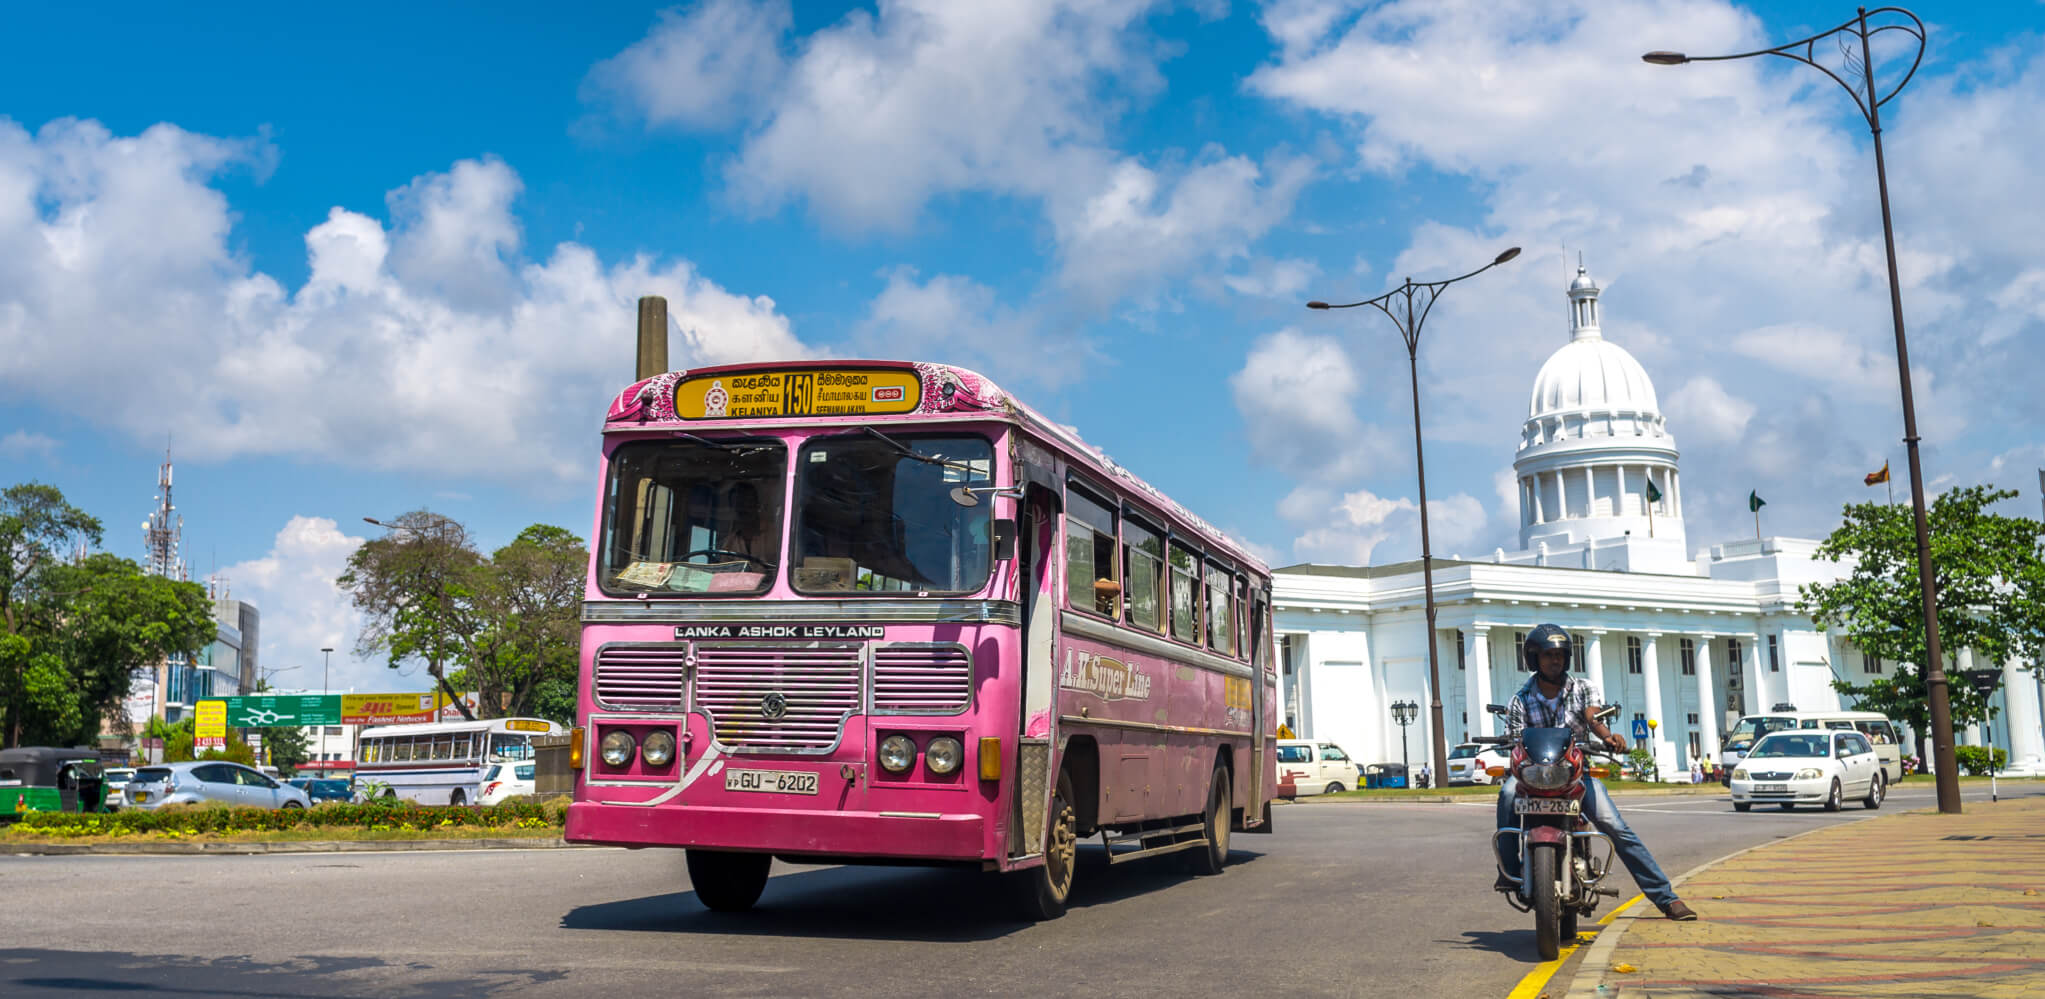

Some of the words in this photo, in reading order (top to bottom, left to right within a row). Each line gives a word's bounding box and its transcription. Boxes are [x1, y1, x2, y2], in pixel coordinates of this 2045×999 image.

[785, 375, 813, 415] 150
[731, 407, 778, 417] KELANIYA
[674, 626, 732, 638] LANKA
[738, 626, 798, 638] ASHOK
[803, 626, 885, 638] LEYLAND
[1125, 661, 1151, 698] Line
